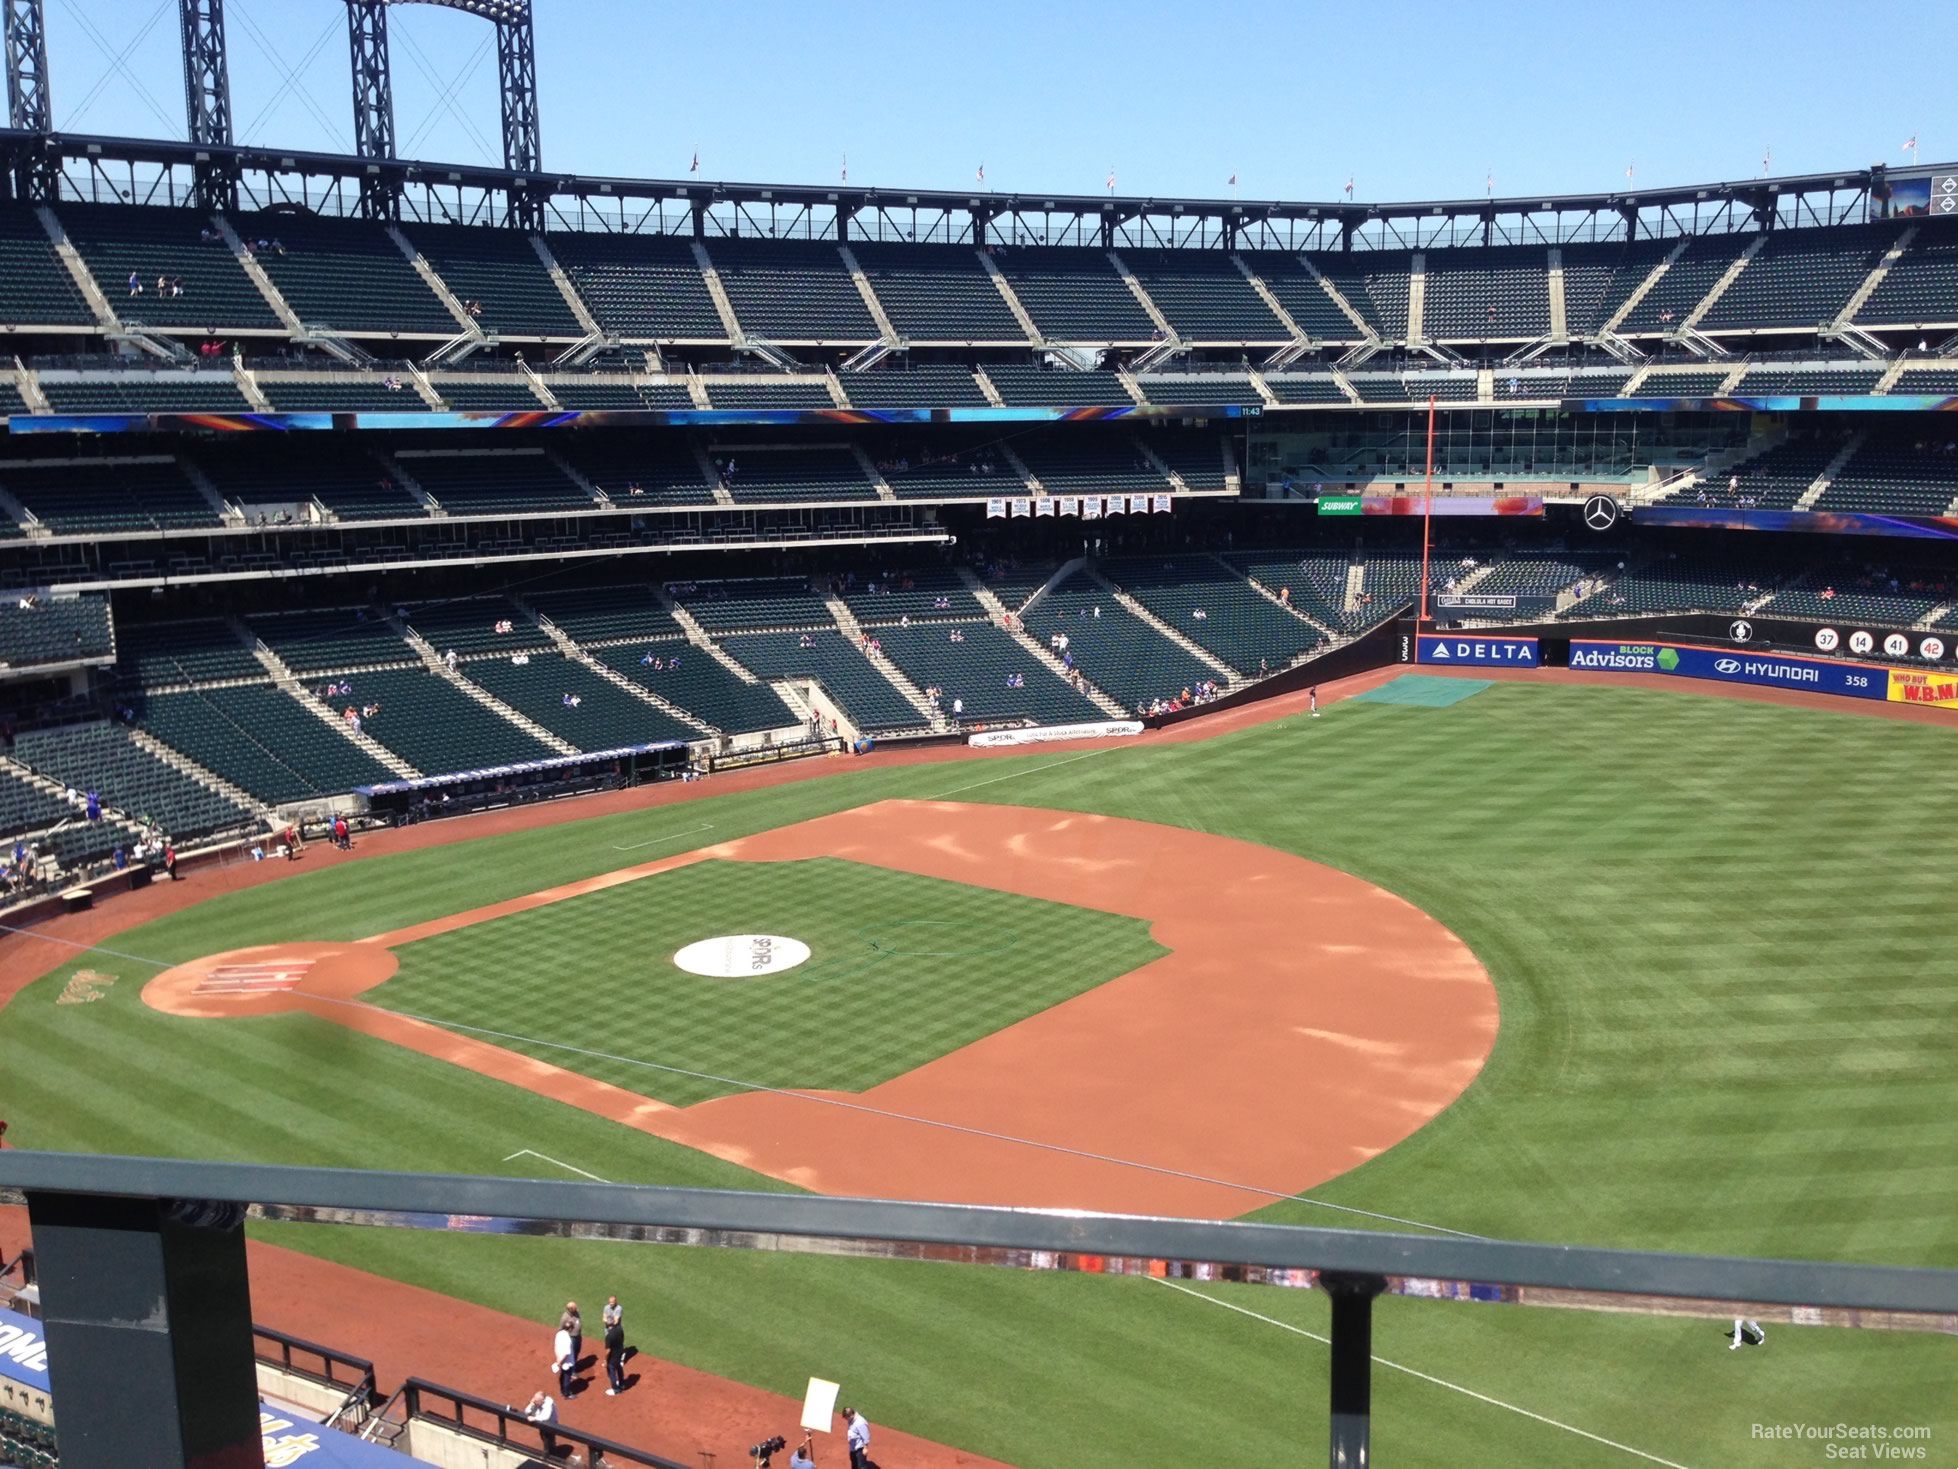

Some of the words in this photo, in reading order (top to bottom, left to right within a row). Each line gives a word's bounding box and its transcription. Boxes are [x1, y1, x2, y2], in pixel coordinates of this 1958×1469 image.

[1321, 501, 1358, 510] SUBWAY
[1819, 634, 1834, 646] 37
[1855, 637, 1866, 648] 14
[1890, 640, 1903, 651] 41
[1401, 636, 1409, 661] 335
[1457, 643, 1532, 660] DELTA
[1619, 645, 1654, 655] BLOCK
[1924, 643, 1939, 655] 42
[1571, 650, 1654, 668] Advisors
[1745, 662, 1819, 682] HYUNDAI
[1845, 675, 1868, 687] 358
[1893, 673, 1910, 682] WHO
[1911, 675, 1928, 684] BUT
